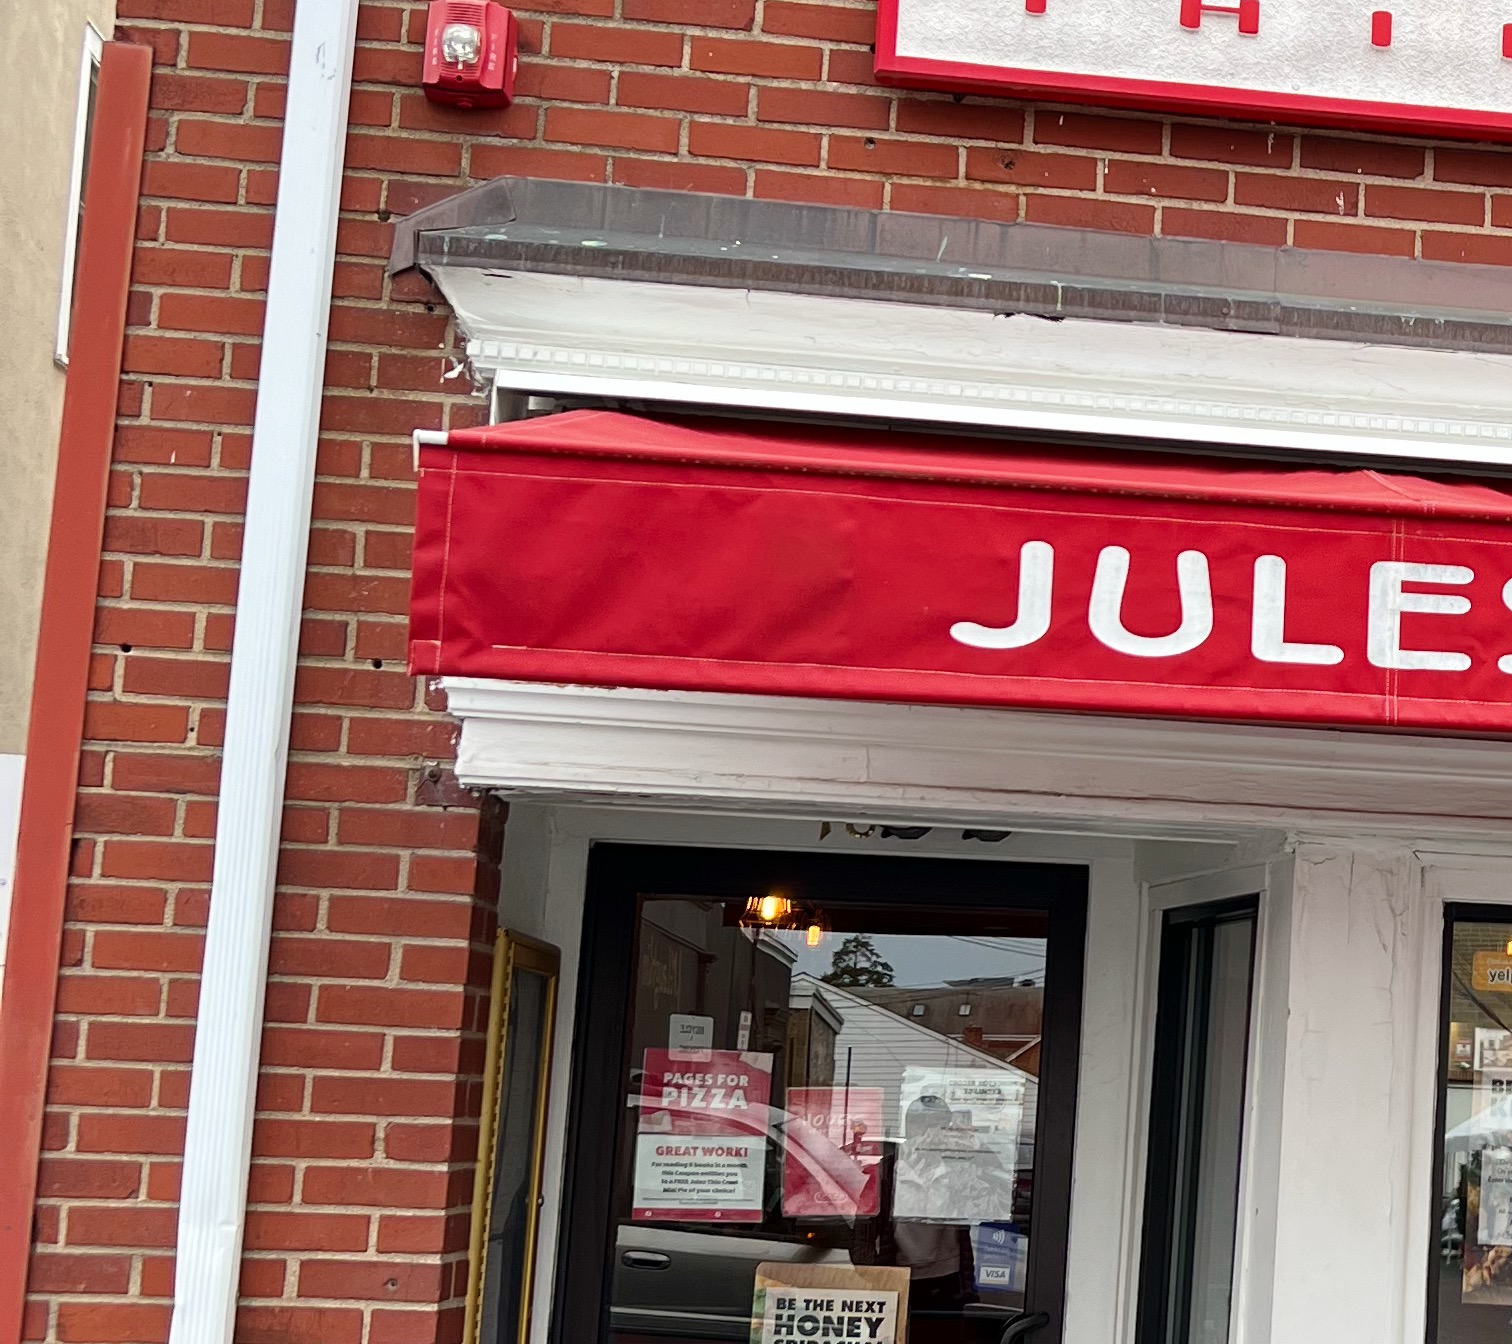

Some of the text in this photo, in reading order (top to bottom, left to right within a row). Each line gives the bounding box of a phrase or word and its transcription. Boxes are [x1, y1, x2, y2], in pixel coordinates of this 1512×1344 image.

[663, 1072, 749, 1087] PAGES FOR
[661, 1087, 749, 1110] PIZZA
[655, 1146, 749, 1158] GREAT WORK!
[985, 1269, 1006, 1279] VISA
[776, 1298, 887, 1314] BE THE NEXT
[773, 1314, 885, 1339] HONEY
